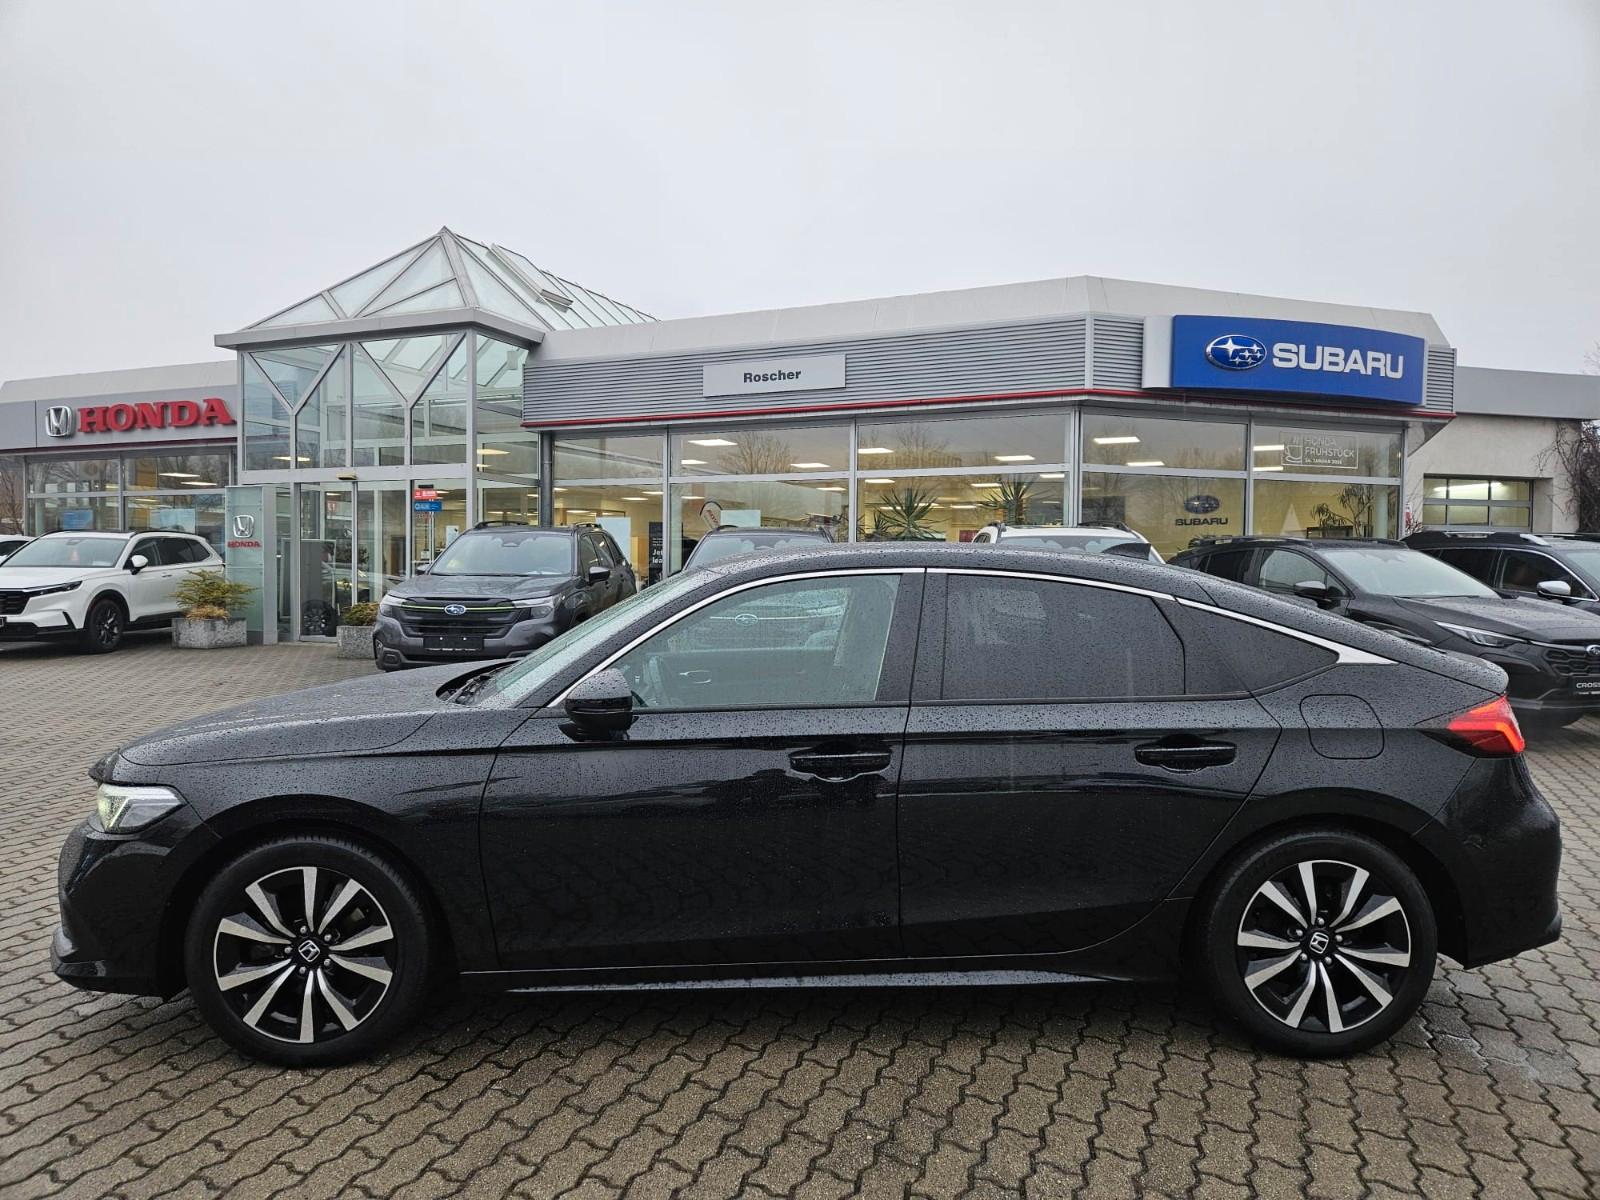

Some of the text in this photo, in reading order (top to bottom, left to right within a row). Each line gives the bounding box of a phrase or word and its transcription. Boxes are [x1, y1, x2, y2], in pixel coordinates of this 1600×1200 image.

[1272, 342, 1404, 379] SUBARU
[743, 369, 802, 383] Roscher
[77, 397, 237, 433] HONDA
[1175, 517, 1229, 526] SUBARU
[227, 540, 262, 549] HONDA
